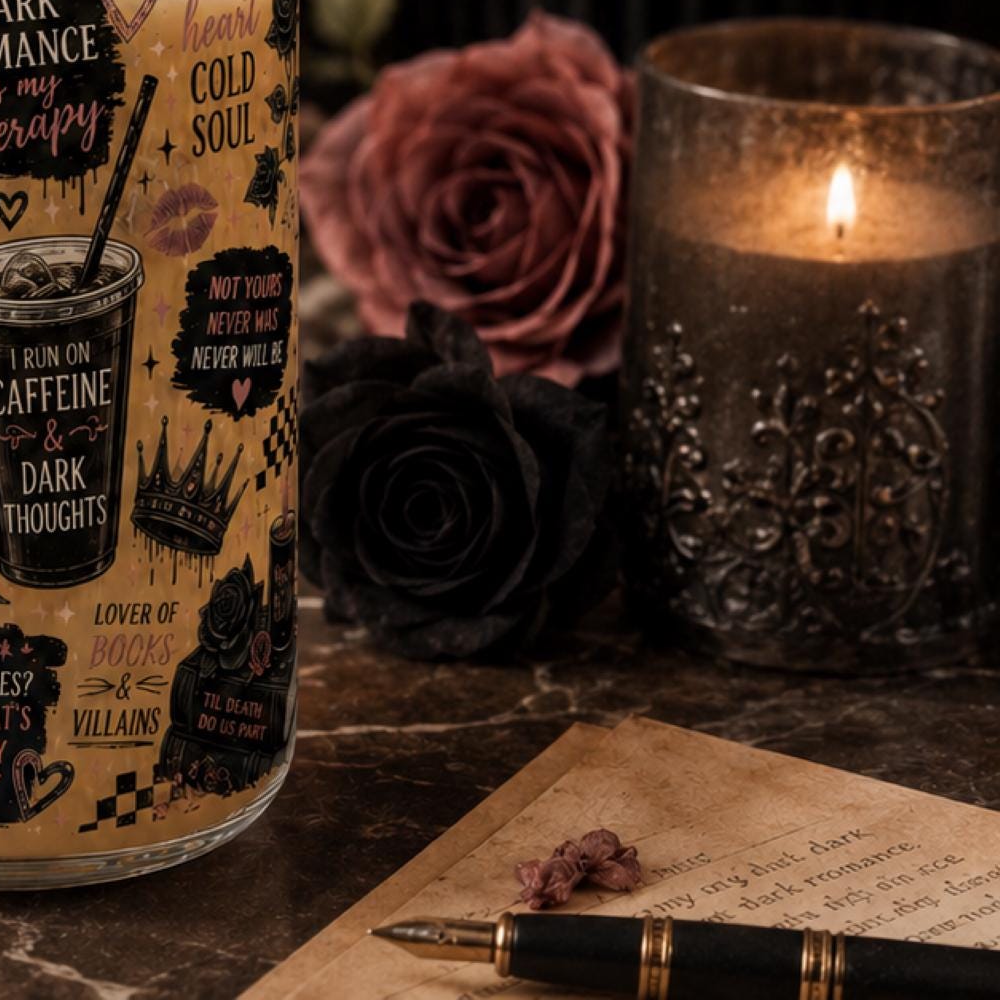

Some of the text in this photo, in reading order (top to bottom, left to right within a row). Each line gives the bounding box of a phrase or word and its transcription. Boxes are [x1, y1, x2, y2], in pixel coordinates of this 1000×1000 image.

[17, 73, 63, 109] my
[190, 50, 256, 105] COLD
[191, 102, 256, 158] SOUL
[209, 272, 283, 300] NOT YOURS
[206, 307, 279, 336] NEVER WAS
[11, 340, 91, 371] I RUN ON
[190, 339, 285, 371] NEVER WILL BE
[43, 418, 64, 451] &
[21, 455, 87, 496] DARK
[3, 494, 108, 535] THOUGHTS
[94, 601, 180, 626] LOVER OF
[89, 632, 176, 670] BOOKS
[115, 672, 131, 700] &
[204, 691, 263, 719] TIL DEATH
[73, 706, 162, 737] VILLAINS
[220, 718, 236, 736] US
[808, 827, 878, 856] dark
